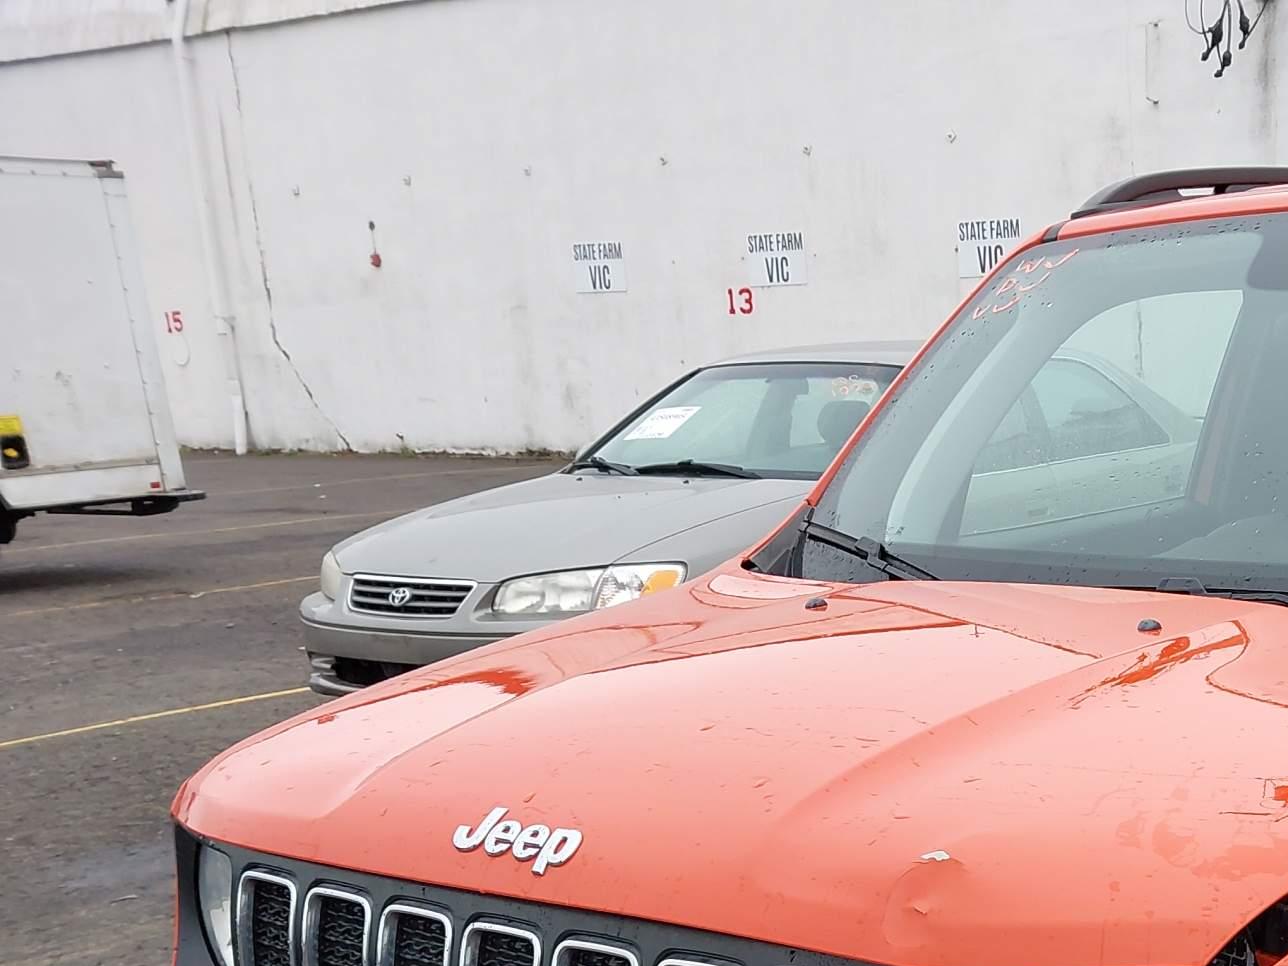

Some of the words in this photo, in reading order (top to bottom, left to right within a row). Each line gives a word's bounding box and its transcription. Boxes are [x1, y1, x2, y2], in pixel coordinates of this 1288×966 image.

[959, 221, 987, 241] STATE
[989, 218, 1020, 240] FARM
[573, 243, 596, 261] STATE
[597, 241, 622, 260] FARM
[747, 235, 775, 253] STATE
[776, 232, 803, 251] FARM
[589, 264, 610, 290] VIC
[764, 256, 789, 283] VIC
[727, 288, 753, 315] 13
[164, 310, 184, 334] 15
[452, 806, 584, 876] Jeep
